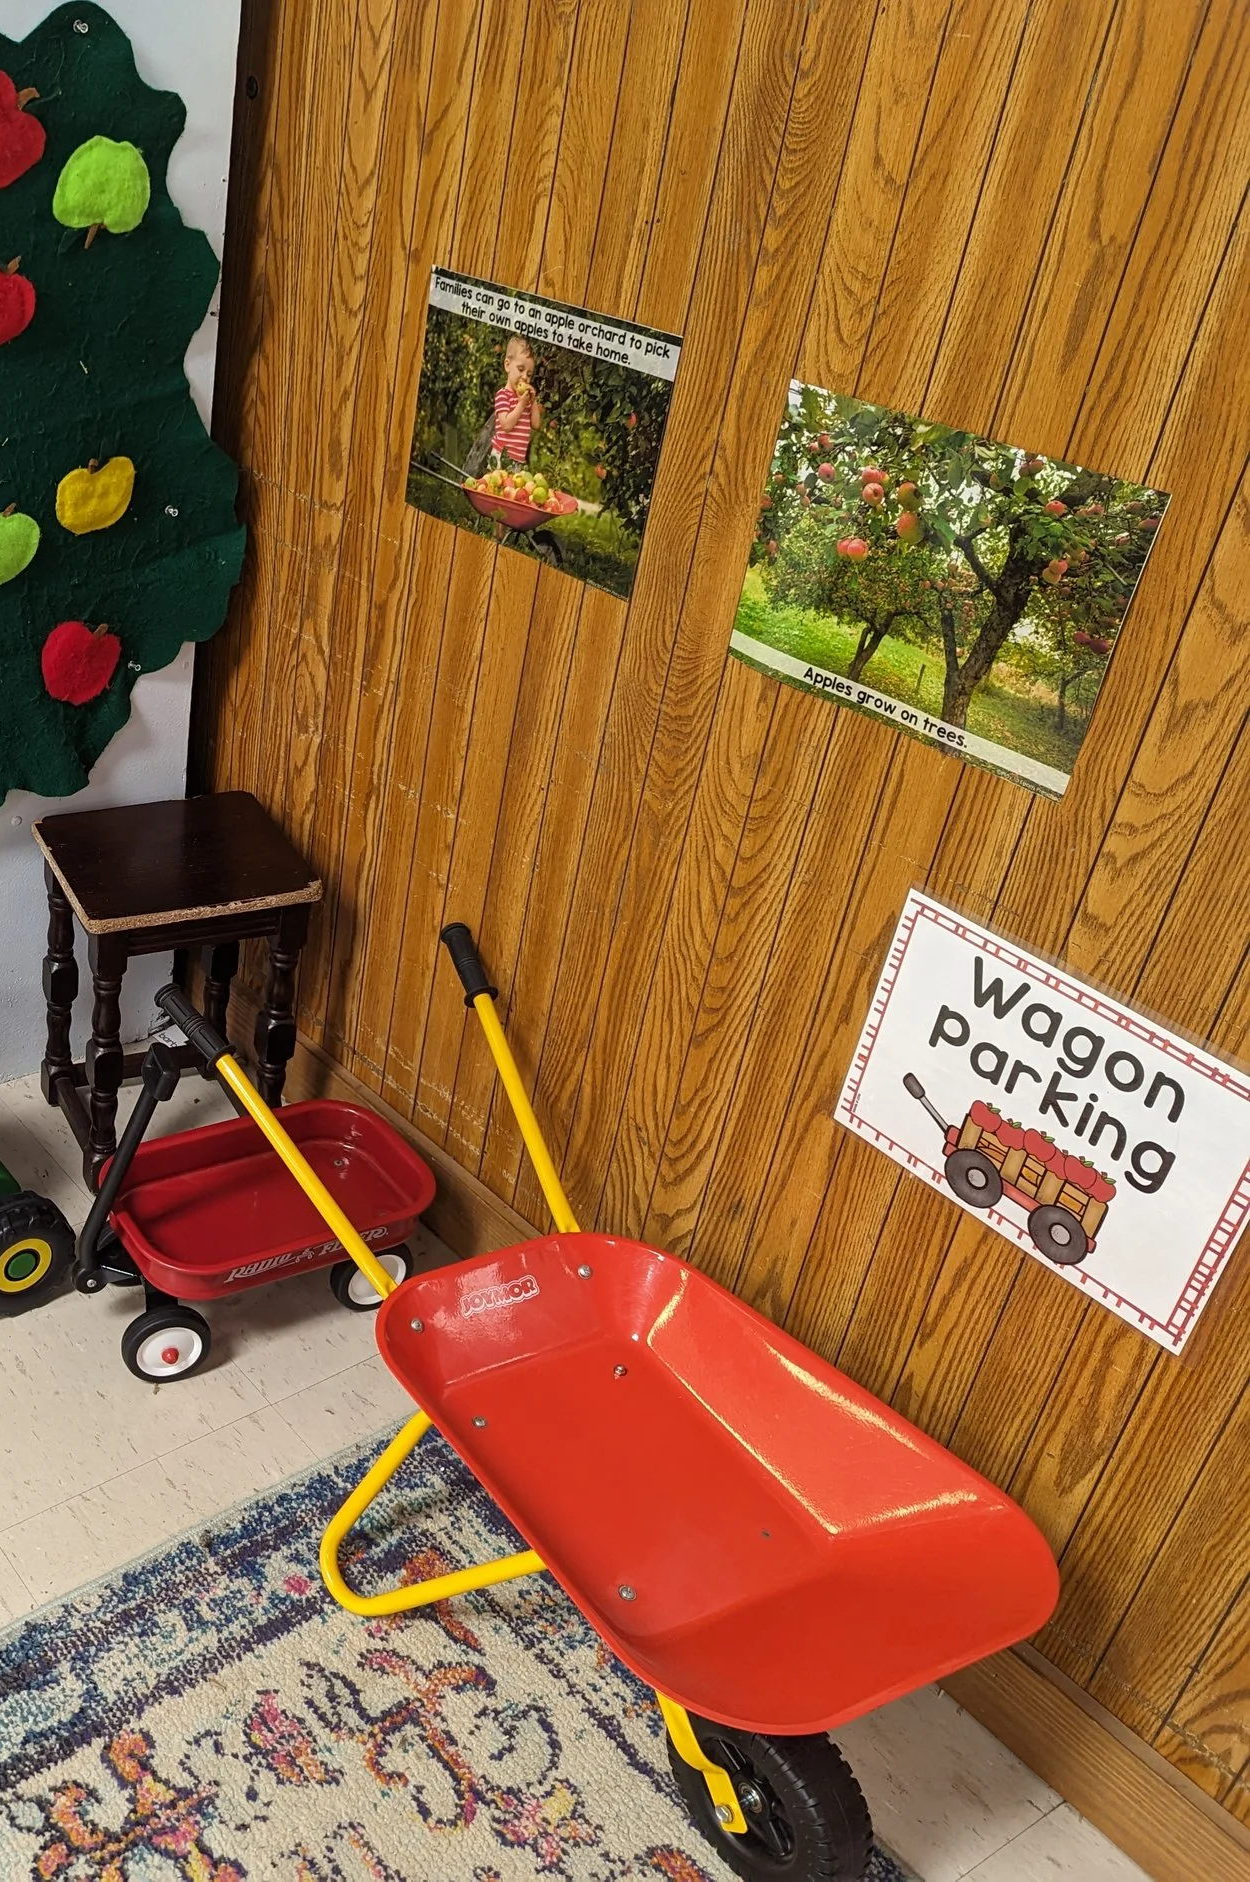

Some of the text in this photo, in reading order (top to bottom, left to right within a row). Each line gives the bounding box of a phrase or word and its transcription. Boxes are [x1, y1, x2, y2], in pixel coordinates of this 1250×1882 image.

[435, 277, 671, 359] Families can go to an apple orchard to pick
[461, 301, 631, 365] their own apples to take home.
[803, 666, 968, 749] Apples grow on trees.
[973, 956, 1185, 1123] Wagon
[928, 1004, 1176, 1194] Parking
[223, 1252, 296, 1284] RADIO
[460, 1275, 540, 1319] JOYMOR
